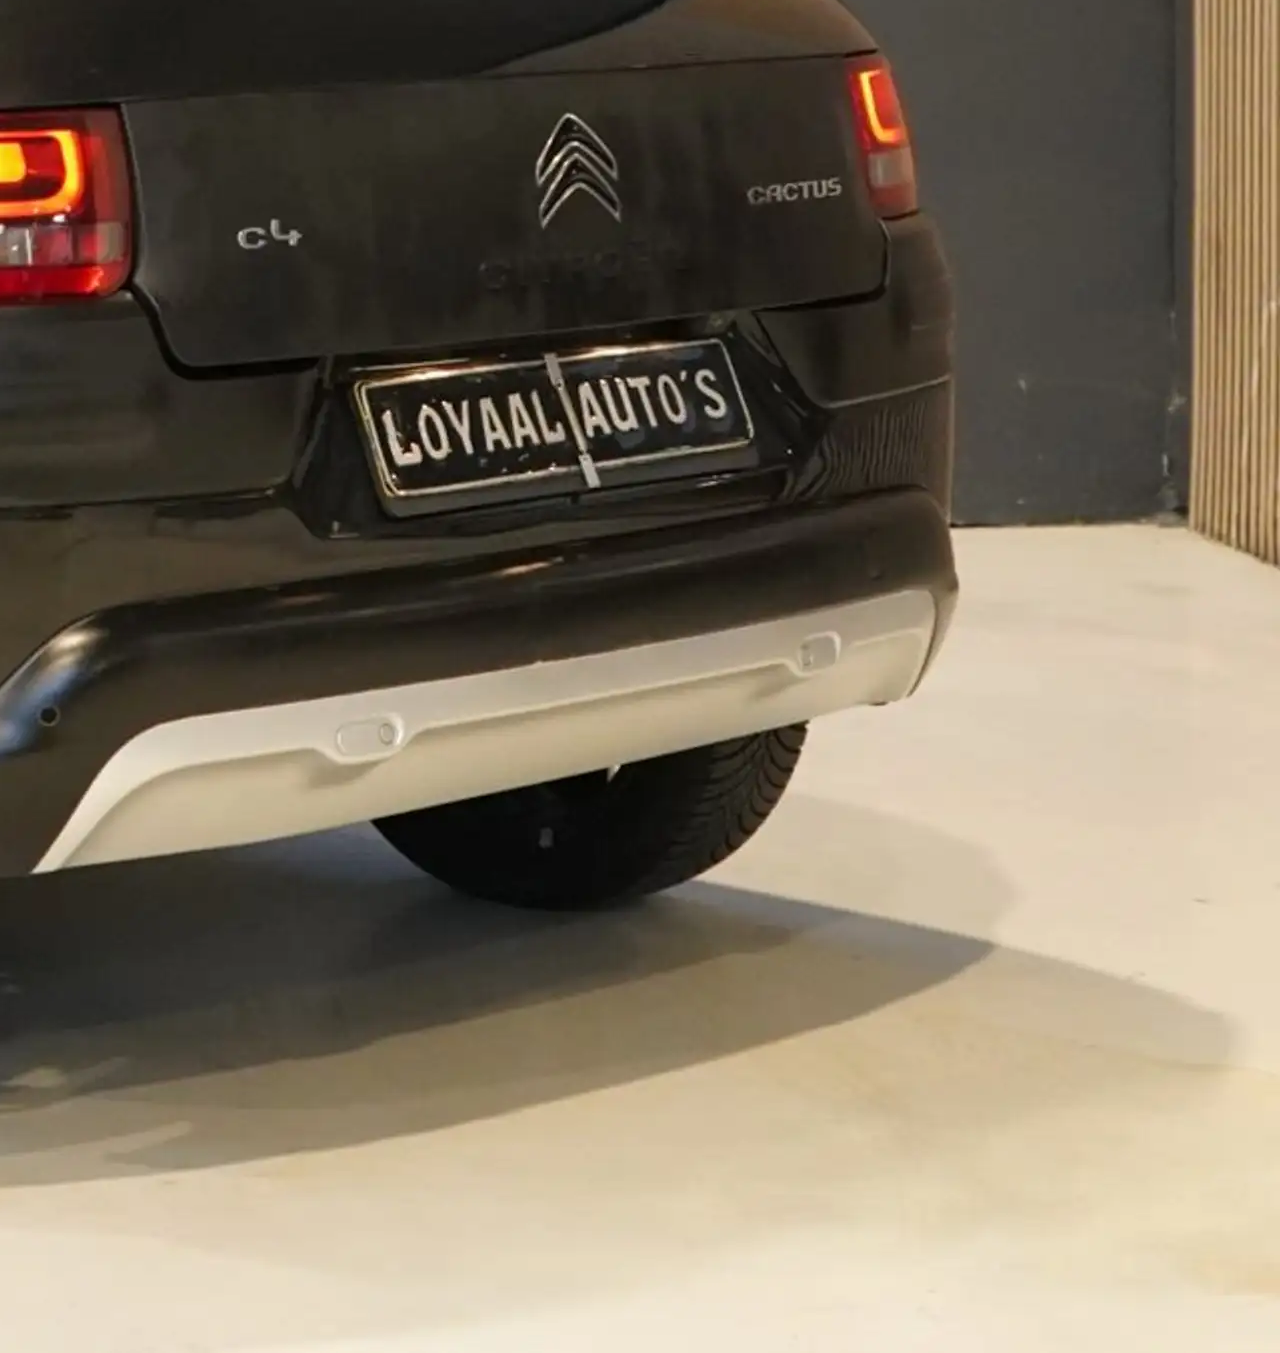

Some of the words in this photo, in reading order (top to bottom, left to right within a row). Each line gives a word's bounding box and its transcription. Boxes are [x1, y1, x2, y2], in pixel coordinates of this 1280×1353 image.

[746, 177, 842, 205] CACTUS
[381, 388, 566, 467] LOYAAL
[576, 368, 727, 439] AUTO'S
